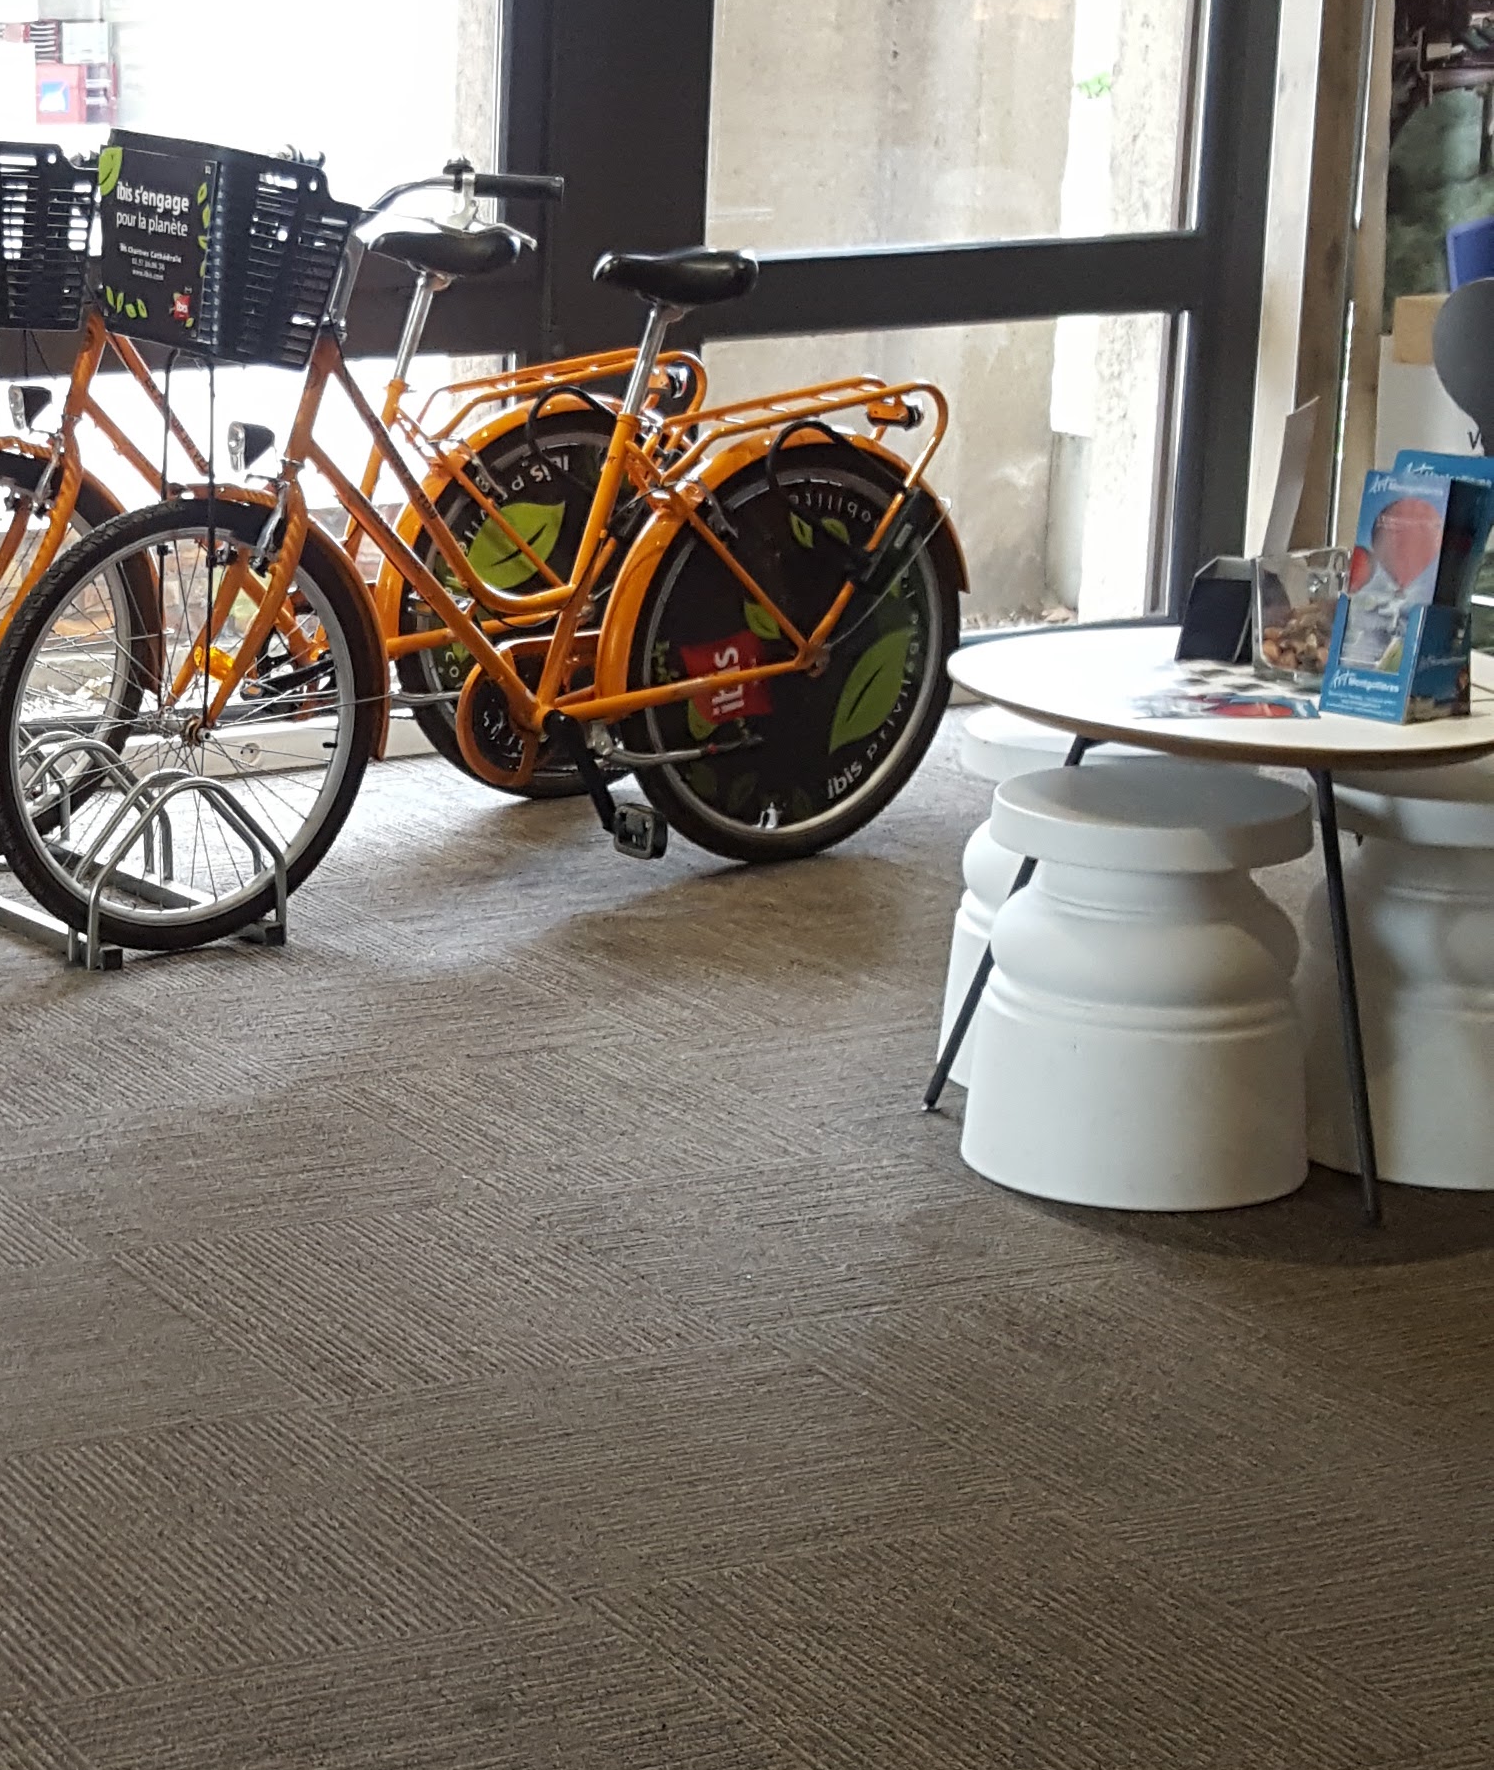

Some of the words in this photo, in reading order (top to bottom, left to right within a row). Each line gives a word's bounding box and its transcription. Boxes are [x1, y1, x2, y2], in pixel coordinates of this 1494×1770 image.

[116, 181, 133, 203] ibis
[134, 185, 190, 216] s'engage
[116, 211, 136, 227] pour
[138, 212, 147, 230] la
[148, 214, 189, 237] planète
